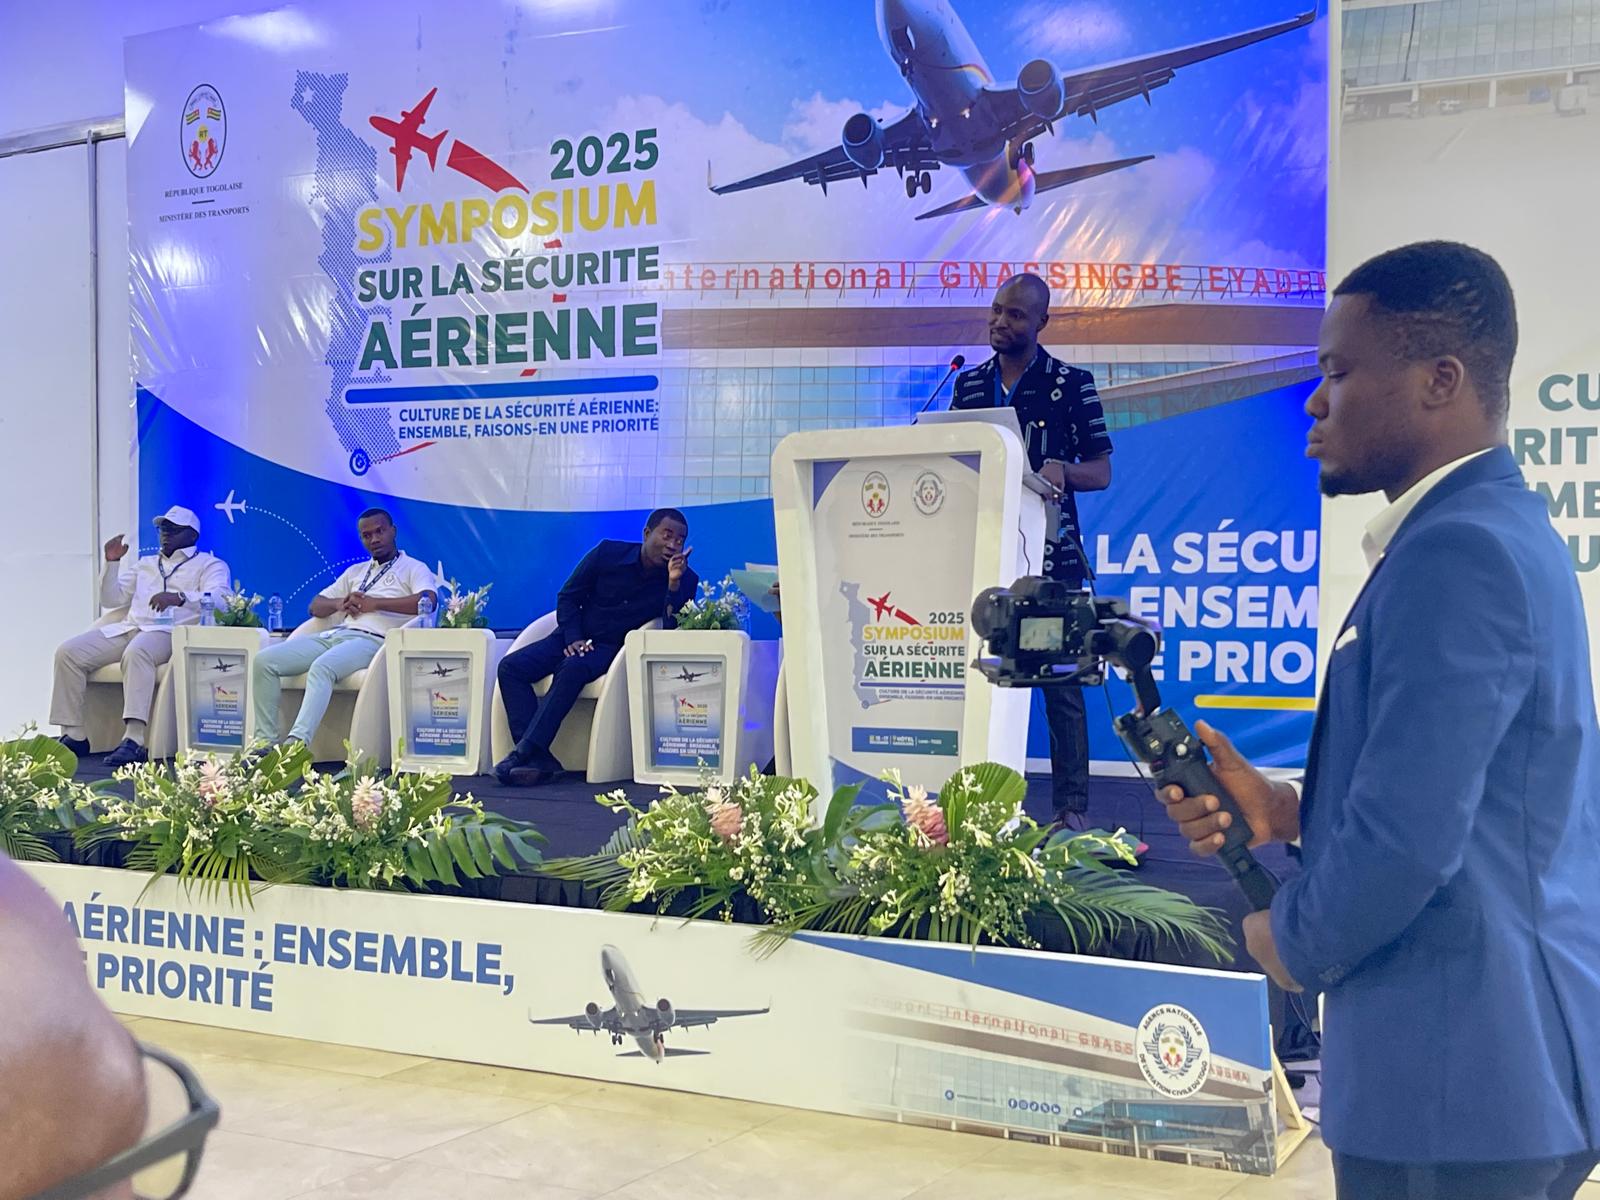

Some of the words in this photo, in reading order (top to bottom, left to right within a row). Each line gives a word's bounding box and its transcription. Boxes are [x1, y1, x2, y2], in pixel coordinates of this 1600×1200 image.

[551, 128, 659, 180] 2025
[206, 182, 243, 192] TOGOLAISE
[194, 210, 206, 219] DES
[208, 206, 250, 217] TRANSPORTS
[358, 180, 658, 251] SYMPOSIUM
[358, 267, 423, 303] SUR
[431, 263, 474, 297] LA
[481, 246, 659, 293] SÉCURITE
[659, 261, 906, 289] nternational
[359, 303, 658, 370] AÉRIENNE
[398, 423, 472, 440] ENSEMBLE,
[475, 420, 557, 437] FAISONS-EN
[560, 419, 589, 435] UNE
[592, 417, 659, 434] PRIORITÉ
[399, 406, 461, 422] CULTURE
[463, 405, 482, 421] DE
[484, 404, 502, 420] LA
[506, 401, 575, 419] SÉCURITÉ
[578, 399, 659, 417] AÉRIENNE:
[1096, 533, 1161, 575] LA
[1171, 519, 1317, 574] SÉCU
[929, 612, 964, 624] 2025
[1130, 585, 1319, 629] ENSEM
[863, 626, 964, 640] SYMPOSIUM
[864, 645, 887, 656] SUR
[890, 645, 904, 656] LA
[907, 643, 965, 657] SÉCURITE
[864, 656, 965, 679] AÉRIENNE
[1179, 640, 1315, 684] PRIO
[63, 892, 245, 957] AÉRIENNE
[273, 923, 515, 996] ENSEMBLE,
[97, 952, 273, 1012] PRIORITÉ
[1171, 1087, 1193, 1096] CIVILE
[1191, 1080, 1201, 1091] DU
[1197, 1060, 1208, 1080] TOGO
